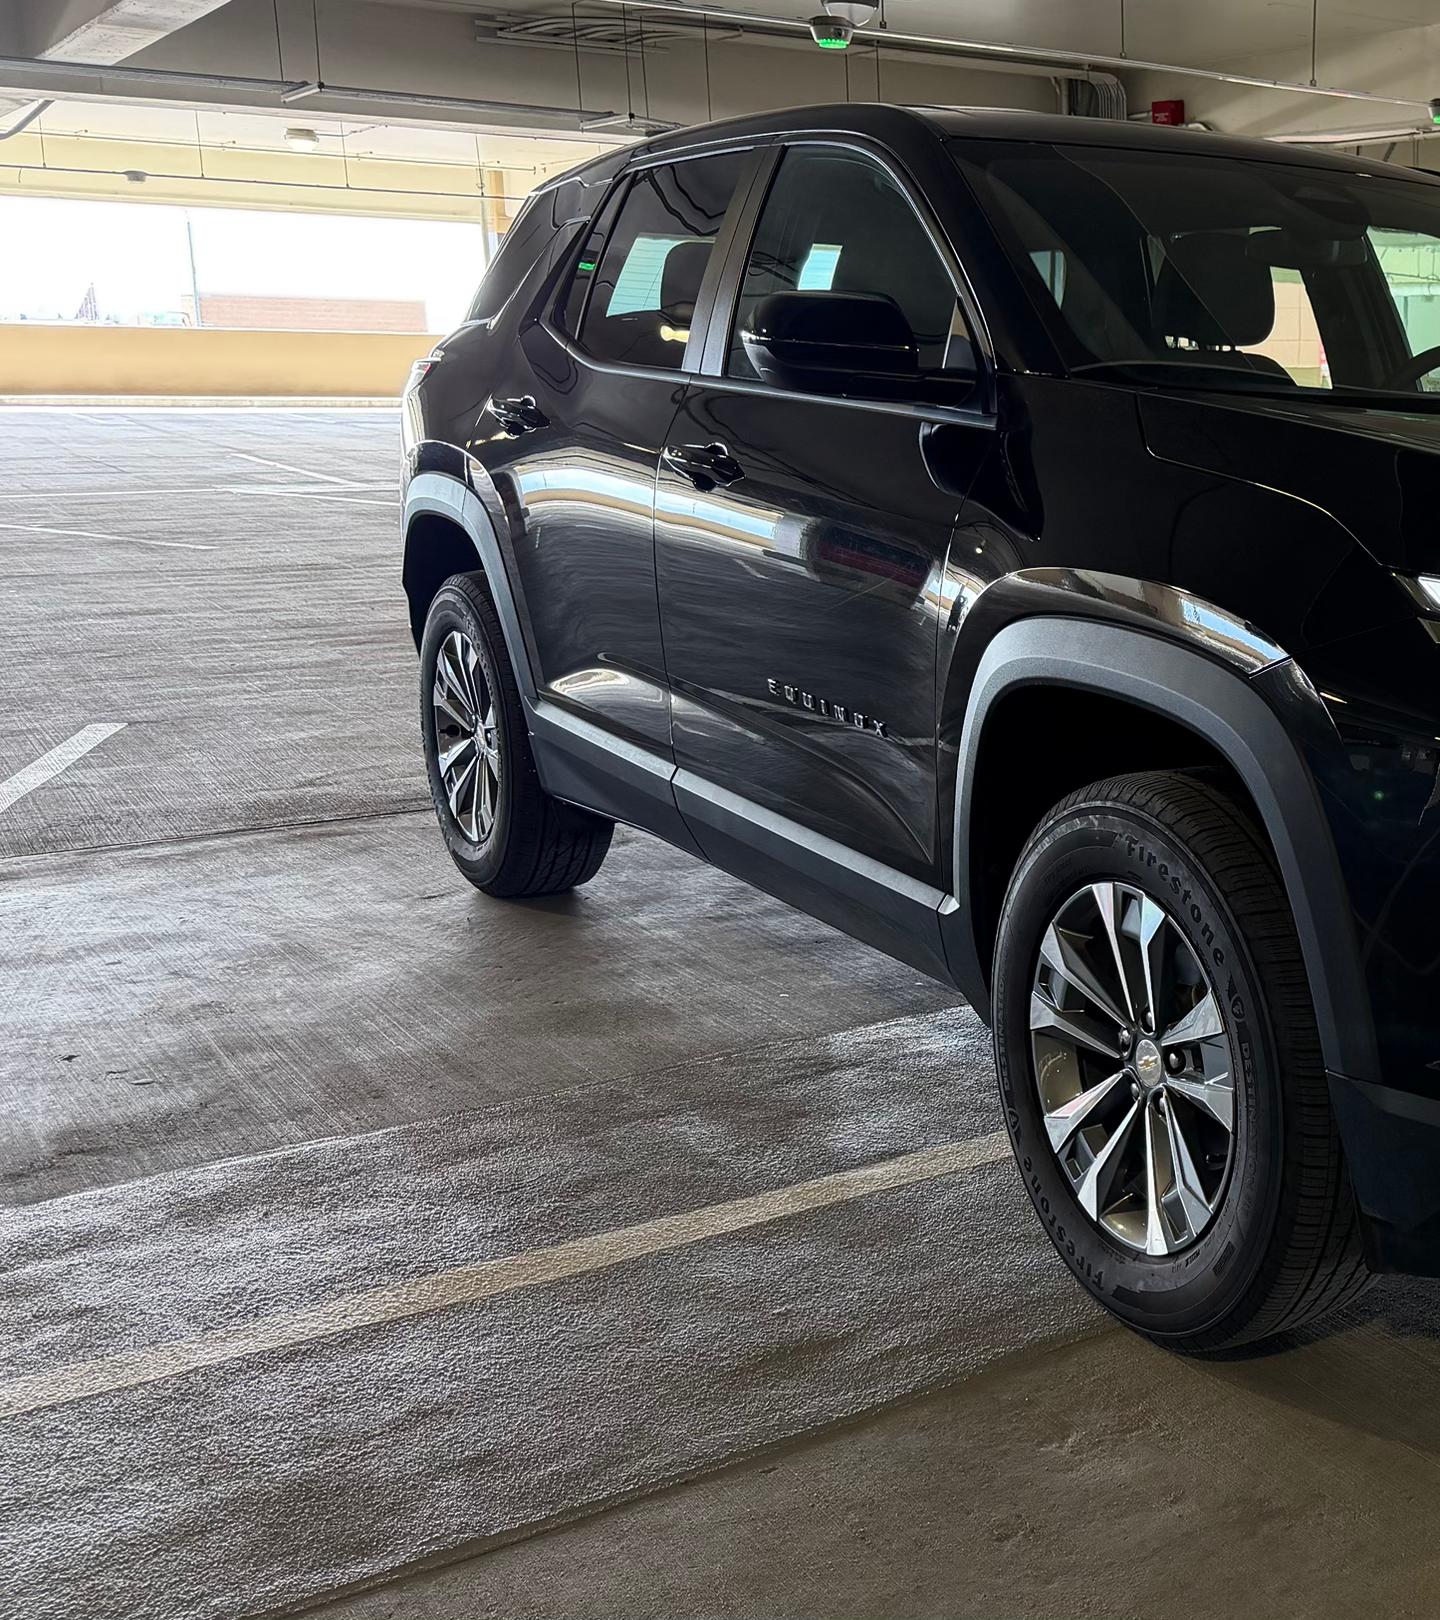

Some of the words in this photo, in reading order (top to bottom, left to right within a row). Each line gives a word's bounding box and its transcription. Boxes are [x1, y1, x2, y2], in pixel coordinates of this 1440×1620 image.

[767, 678, 887, 738] EQUINOX
[1125, 833, 1225, 968] Firestone
[1023, 1154, 1105, 1291] Firestone
